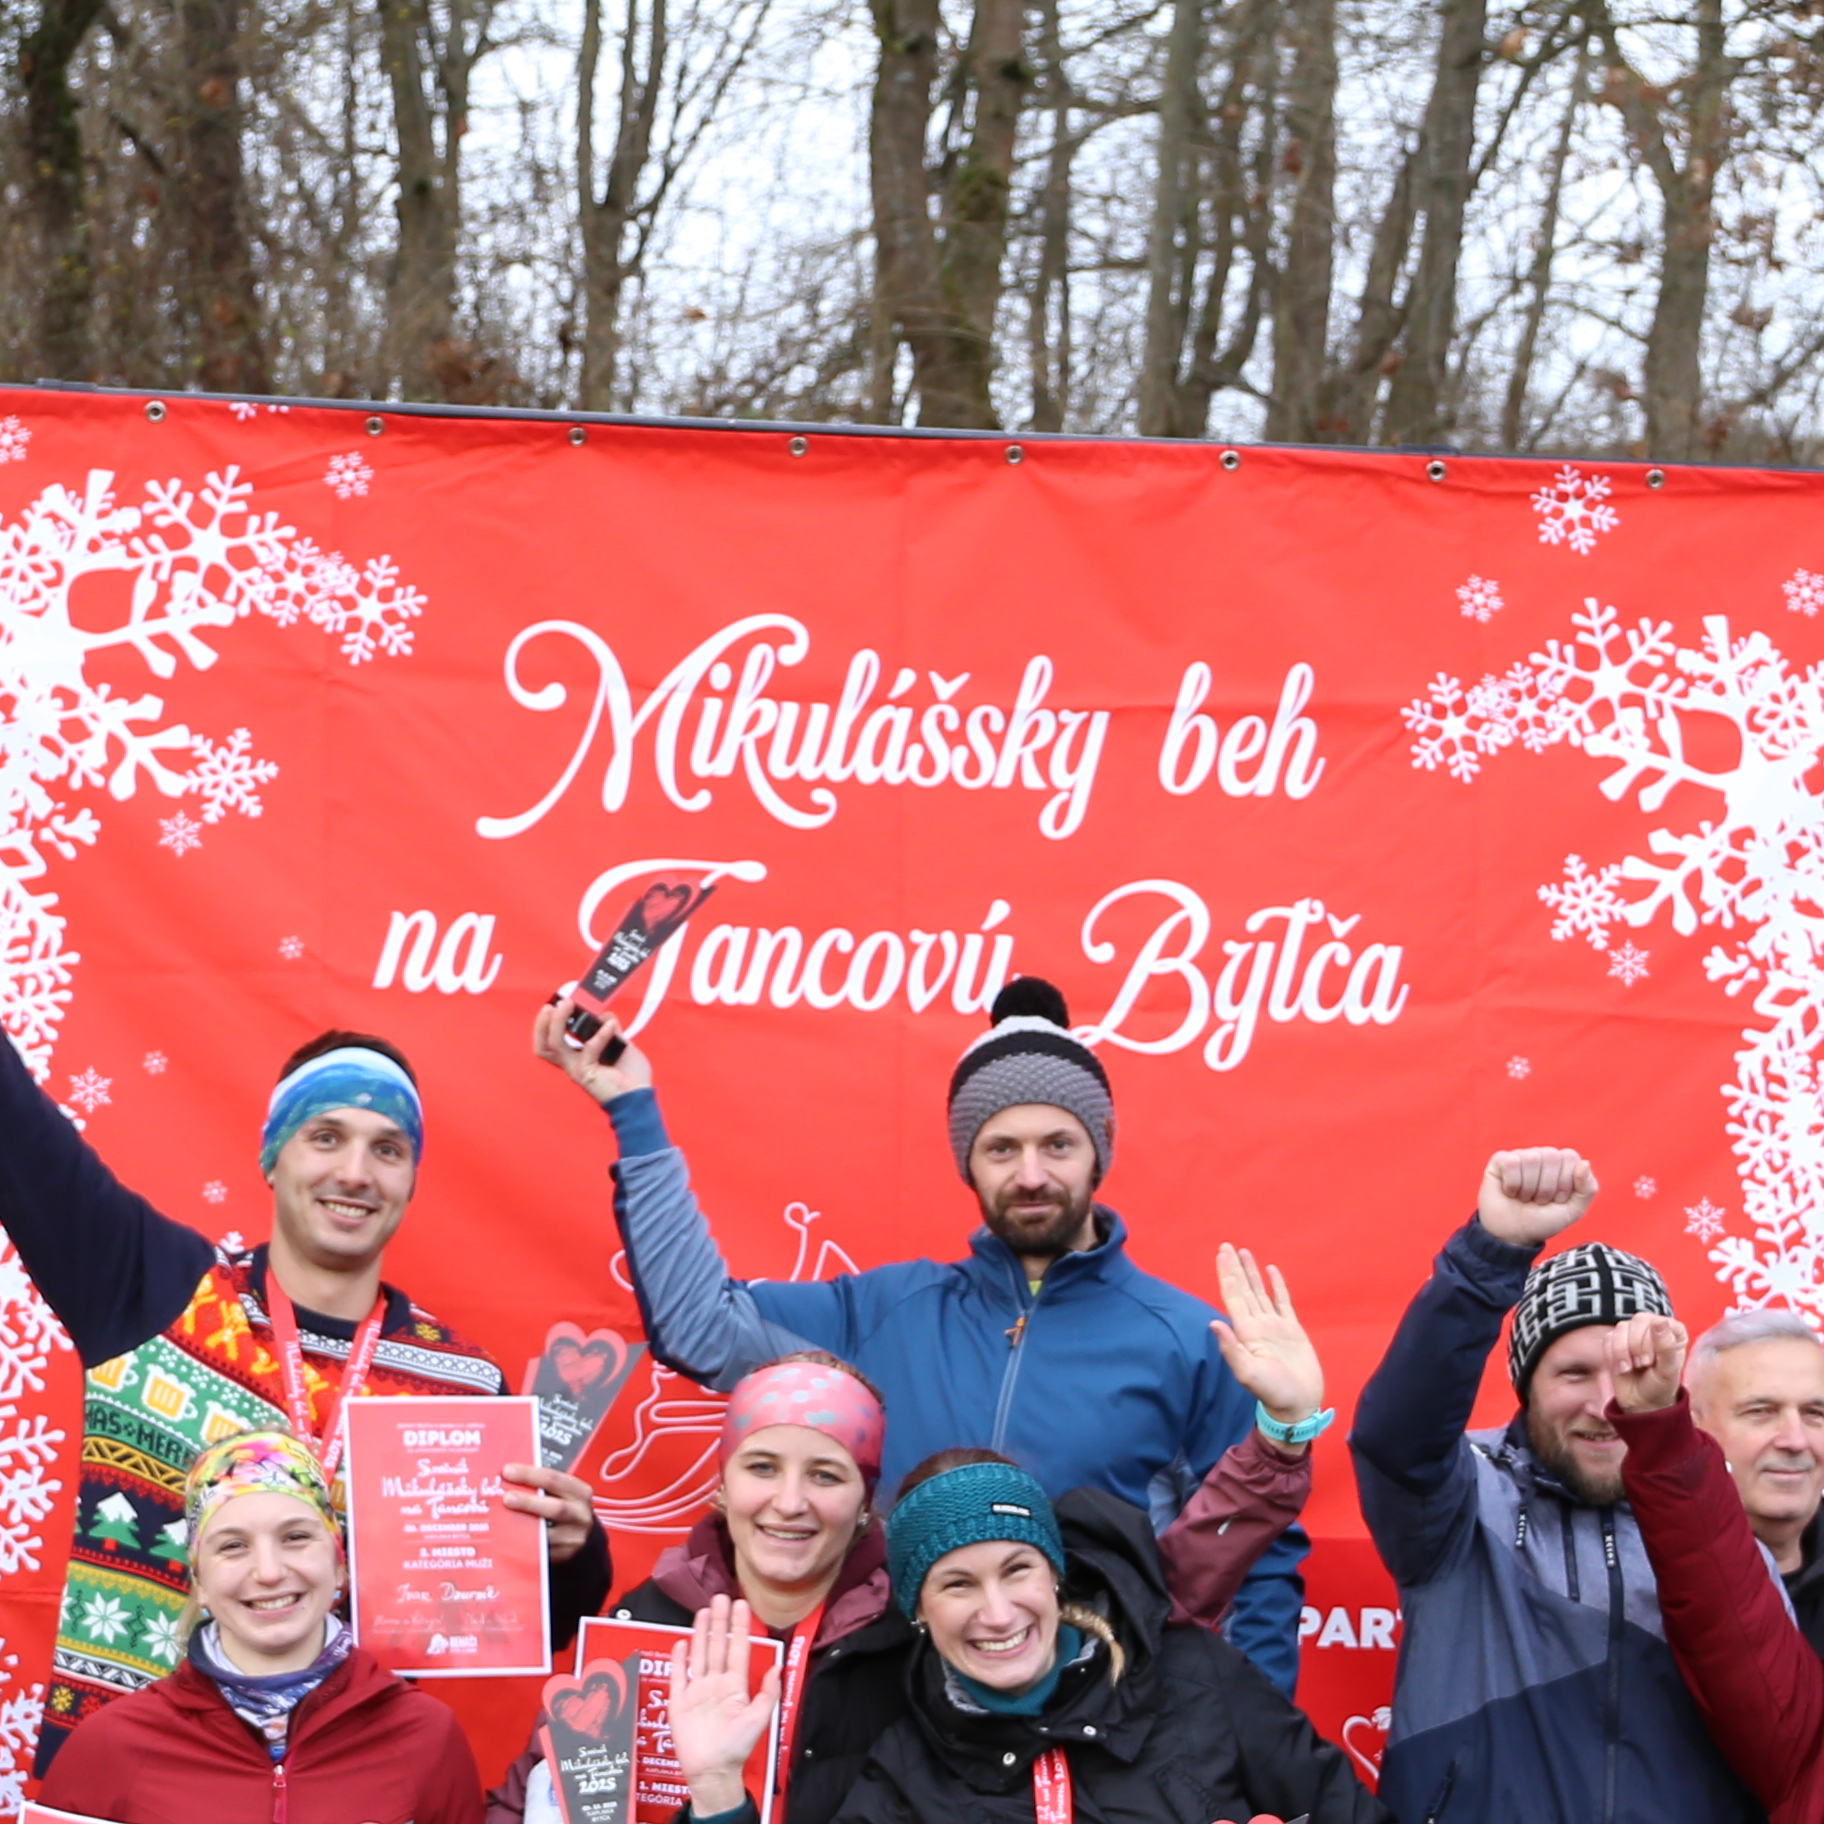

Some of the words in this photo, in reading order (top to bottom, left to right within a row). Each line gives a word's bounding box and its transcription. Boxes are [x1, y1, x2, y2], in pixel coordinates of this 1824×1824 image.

[476, 613, 1111, 841] Mikulášsky
[1157, 661, 1326, 800] beh
[373, 907, 502, 994] na
[403, 1429, 481, 1446] DIPLOM
[419, 1546, 429, 1558] 2.
[431, 1546, 476, 1557] MIESTO
[402, 1558, 463, 1569] KATEGÓRIA
[579, 1777, 617, 1794] 2025
[651, 1782, 691, 1794] MIEST
